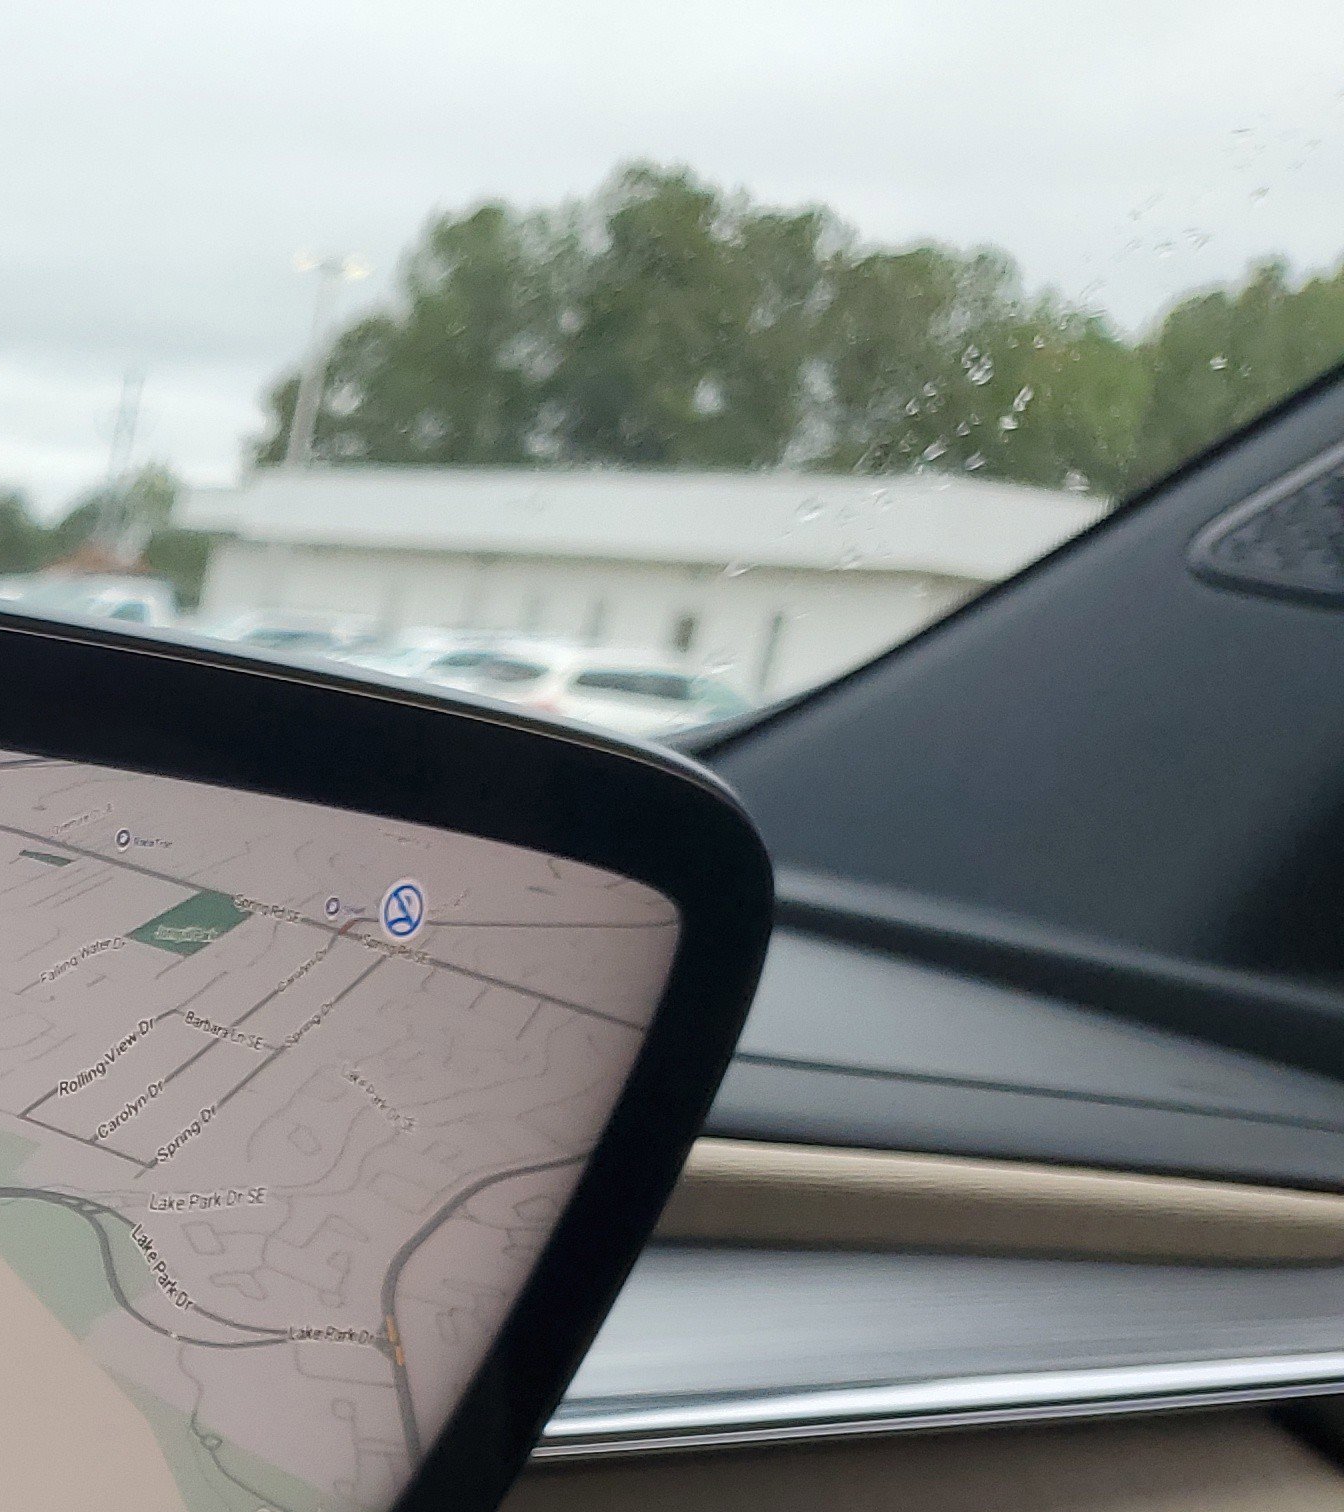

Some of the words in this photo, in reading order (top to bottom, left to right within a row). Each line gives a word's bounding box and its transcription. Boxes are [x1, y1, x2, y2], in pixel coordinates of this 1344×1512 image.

[59, 1061, 106, 1095] Rolling
[138, 1018, 155, 1034] Dr
[97, 1097, 147, 1139] Carolyn
[147, 1080, 165, 1098] Dr
[157, 1119, 201, 1162] Spring
[200, 1105, 216, 1122] Dr
[149, 1193, 184, 1211] Lake
[189, 1193, 220, 1209] Park
[248, 1187, 267, 1204] SE
[131, 1224, 157, 1263] Lake
[153, 1261, 178, 1297] Park
[175, 1291, 193, 1309] Dr
